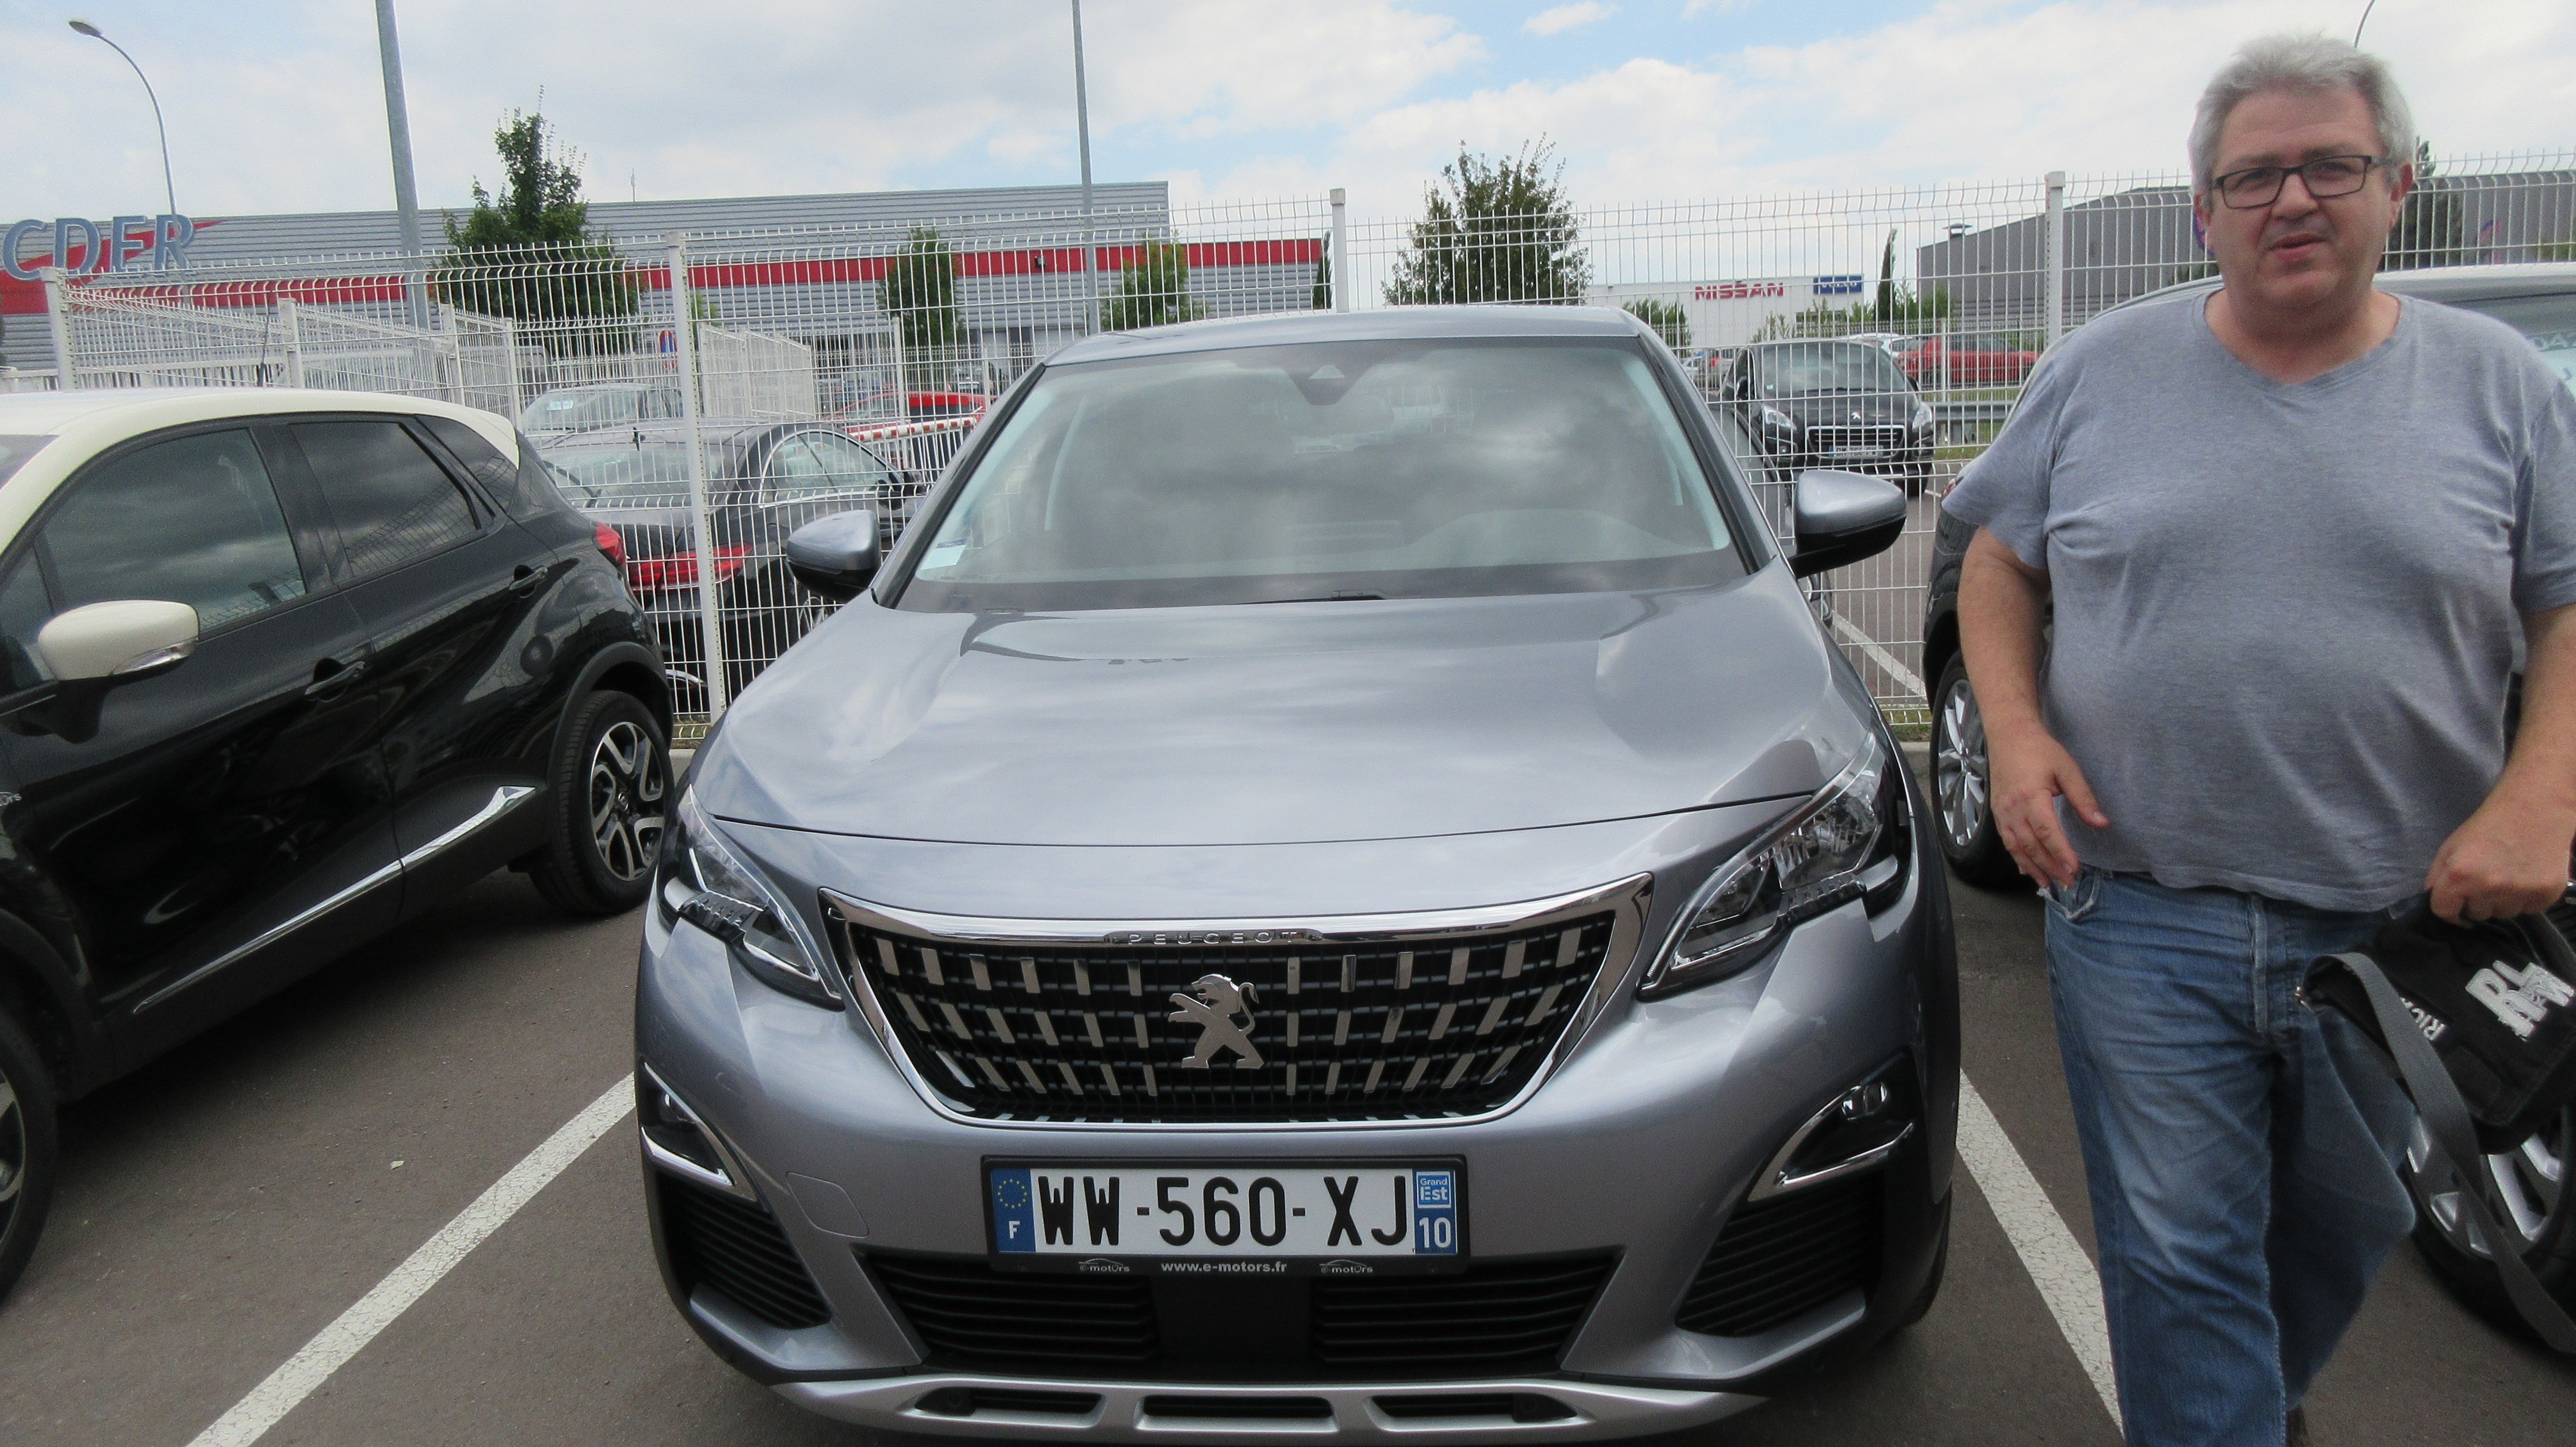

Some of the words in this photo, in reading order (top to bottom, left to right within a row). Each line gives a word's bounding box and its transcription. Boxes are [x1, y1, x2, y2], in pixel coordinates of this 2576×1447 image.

[2, 214, 198, 281] CDER
[1695, 282, 1784, 300] NISSAN
[1128, 931, 1297, 945] PEUGEOT
[1420, 1186, 1448, 1201] Est
[1008, 1220, 1021, 1239] F
[1419, 1217, 1451, 1248] 10
[1160, 1261, 1287, 1273] www.e-motors.fr
